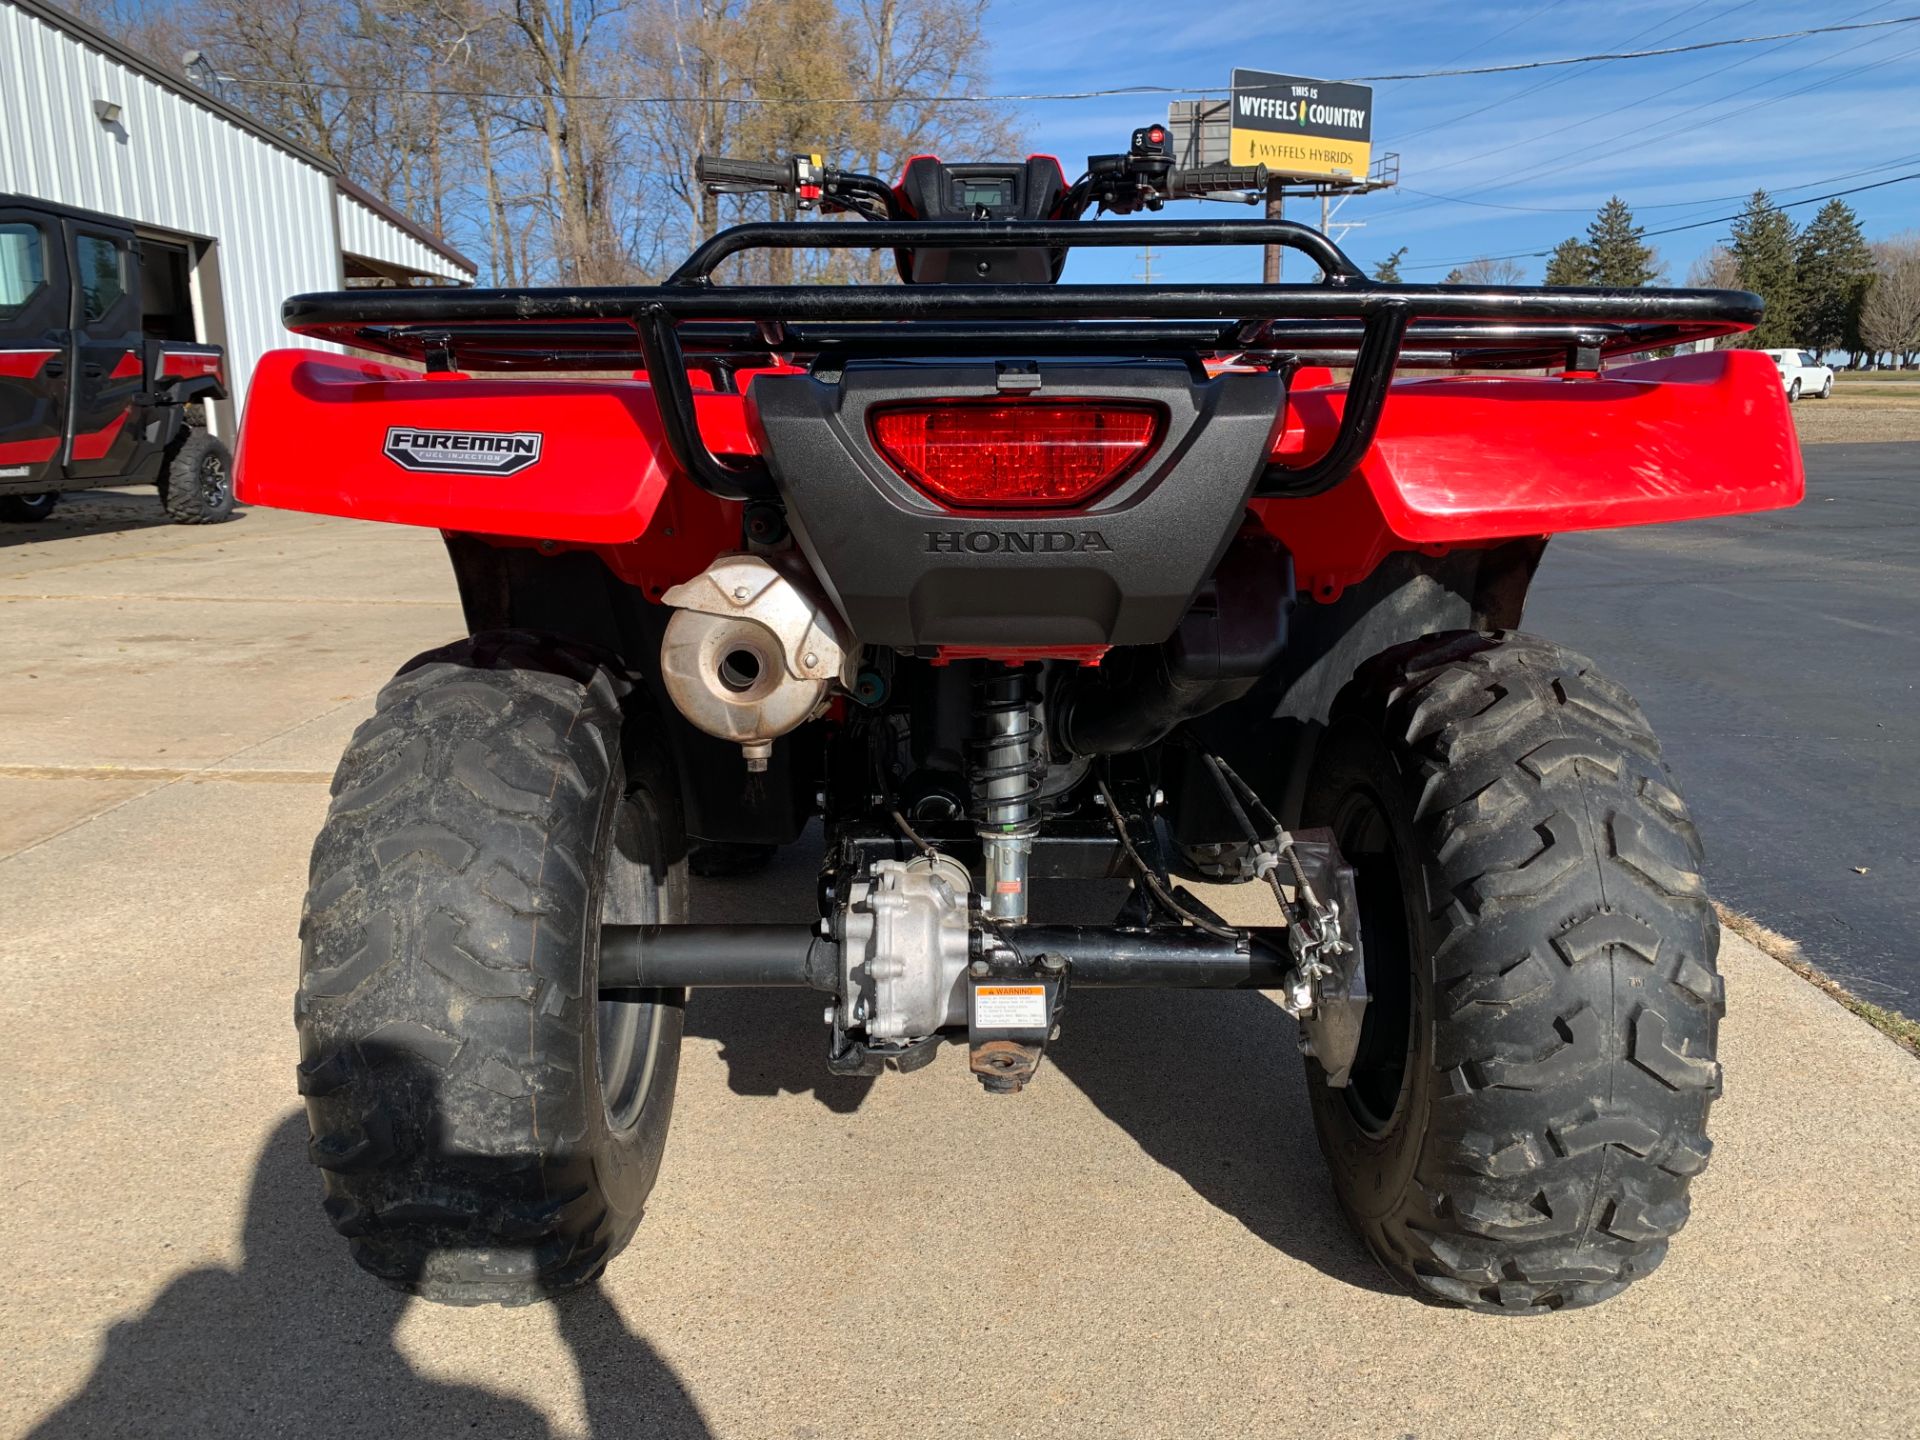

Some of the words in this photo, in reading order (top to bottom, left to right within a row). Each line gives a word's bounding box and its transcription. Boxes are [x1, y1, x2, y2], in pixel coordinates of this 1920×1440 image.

[1291, 86, 1309, 97] THIS
[1310, 88, 1318, 99] IS
[1239, 95, 1297, 121] WYFFELS
[1309, 104, 1365, 129] COUNTRY
[1260, 143, 1306, 160] WYFFELS
[1309, 149, 1354, 165] HYBRIDS
[391, 433, 535, 454] FOREMAN
[448, 452, 501, 461] INJECTION
[923, 531, 1114, 554] HONDA
[996, 987, 1033, 995] WARNING
